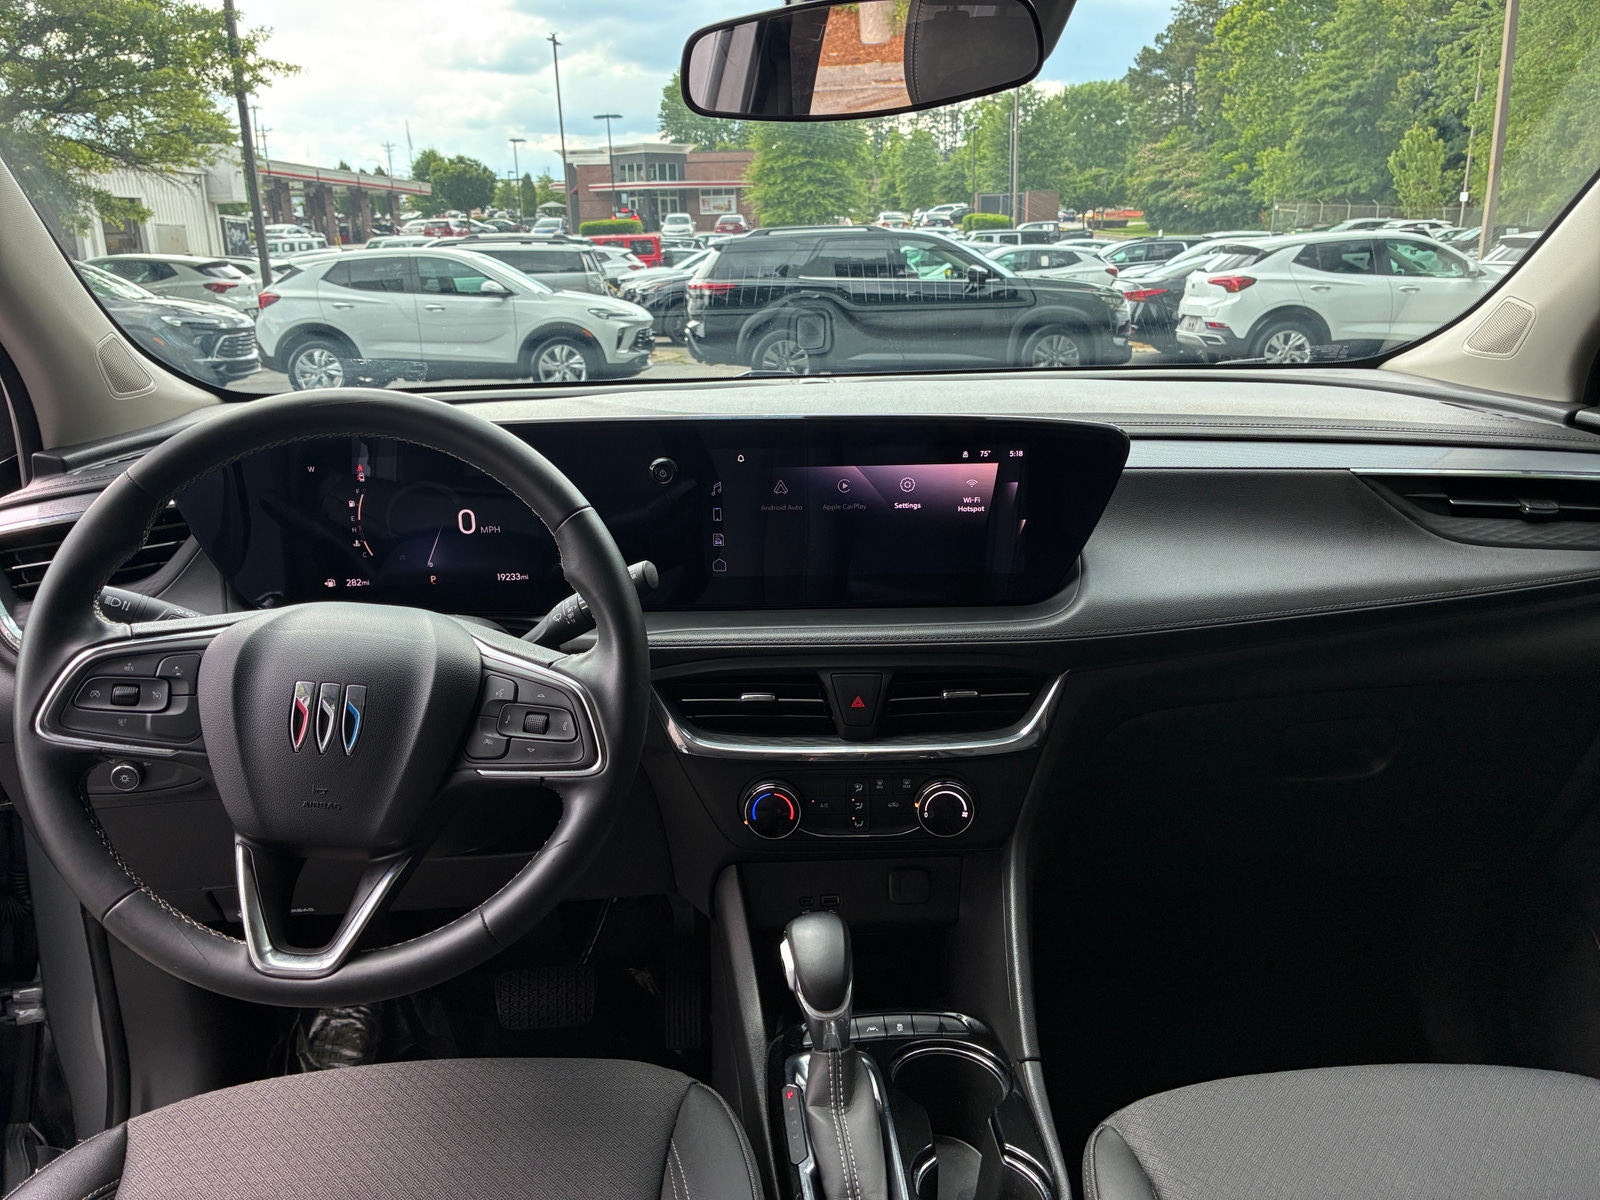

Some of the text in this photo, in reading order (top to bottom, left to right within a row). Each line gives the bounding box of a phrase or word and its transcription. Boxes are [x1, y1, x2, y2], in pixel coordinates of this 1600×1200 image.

[822, 503, 867, 511] Apple CarPlay
[894, 502, 922, 510] Settings
[957, 505, 985, 513] Hotspot
[457, 508, 501, 535] 0 MPH
[430, 575, 437, 583] P
[302, 800, 341, 810] AIRBAG
[786, 1091, 794, 1099] P
